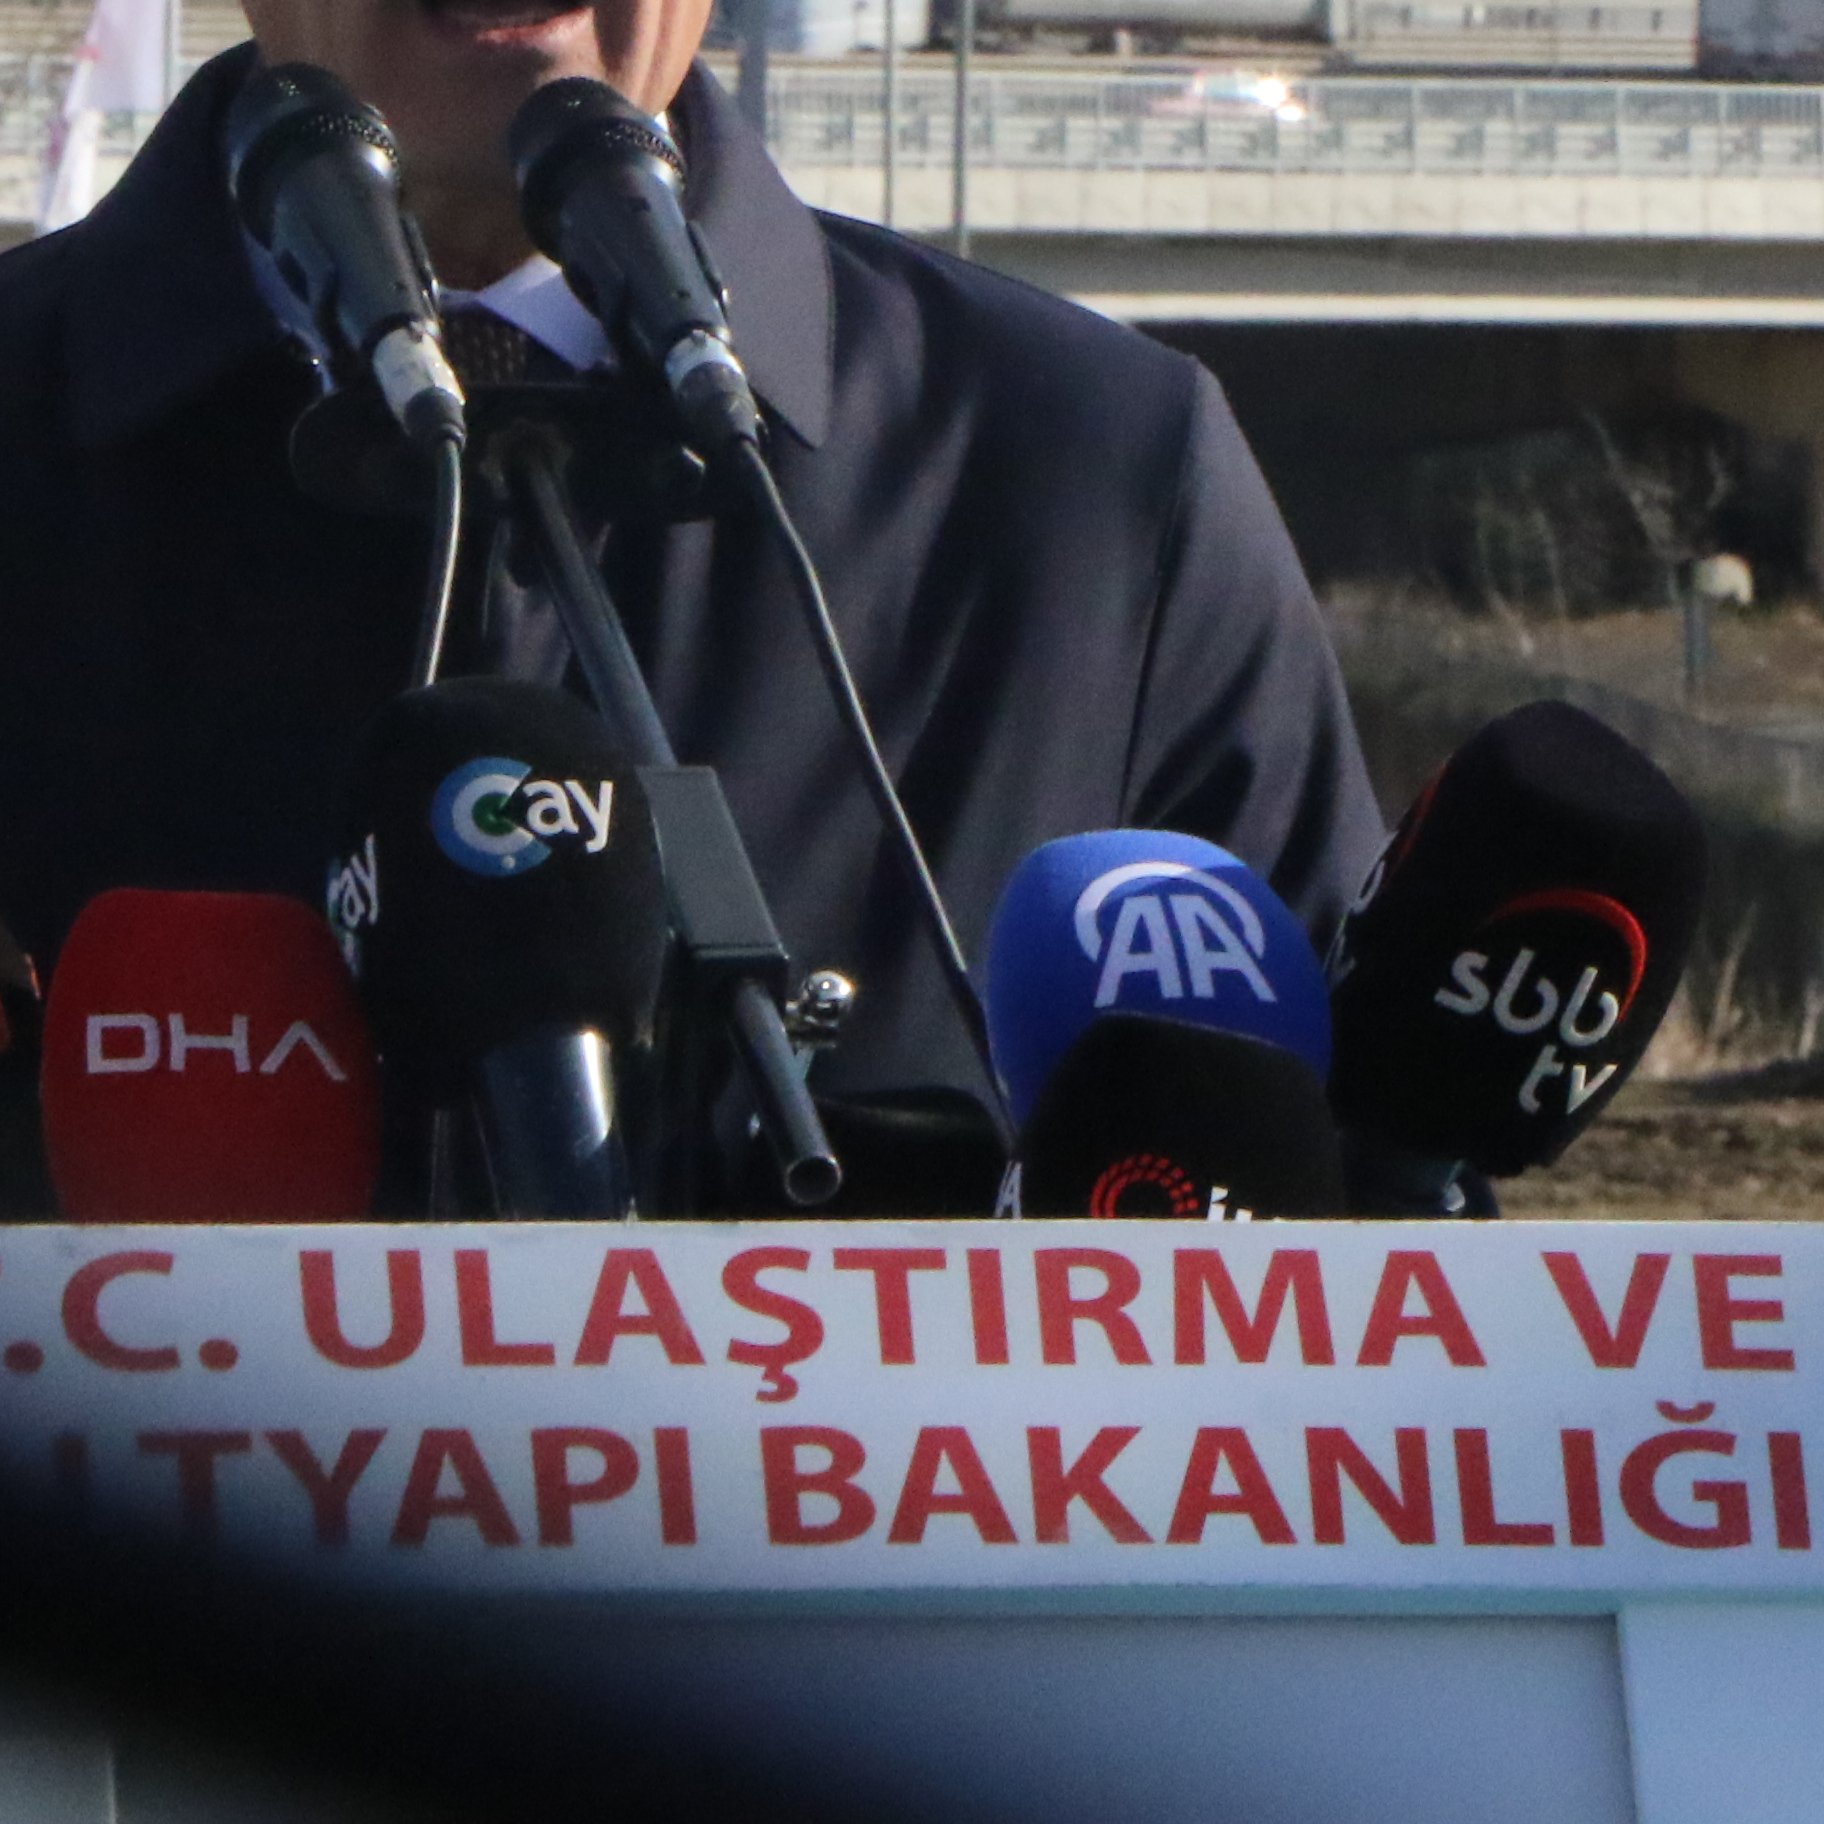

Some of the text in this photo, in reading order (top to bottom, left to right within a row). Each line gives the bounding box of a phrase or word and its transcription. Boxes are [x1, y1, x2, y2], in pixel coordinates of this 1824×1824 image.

[1094, 894, 1277, 1009] AA
[1432, 945, 1620, 1048] sbb
[85, 1012, 348, 1082] DHA
[1517, 1044, 1618, 1115] tv
[297, 1245, 1488, 1403] ULAŞTIRMA
[1541, 1250, 1797, 1373] VE
[48, 1398, 1813, 1552] TYAPI BAKANLIĞI
